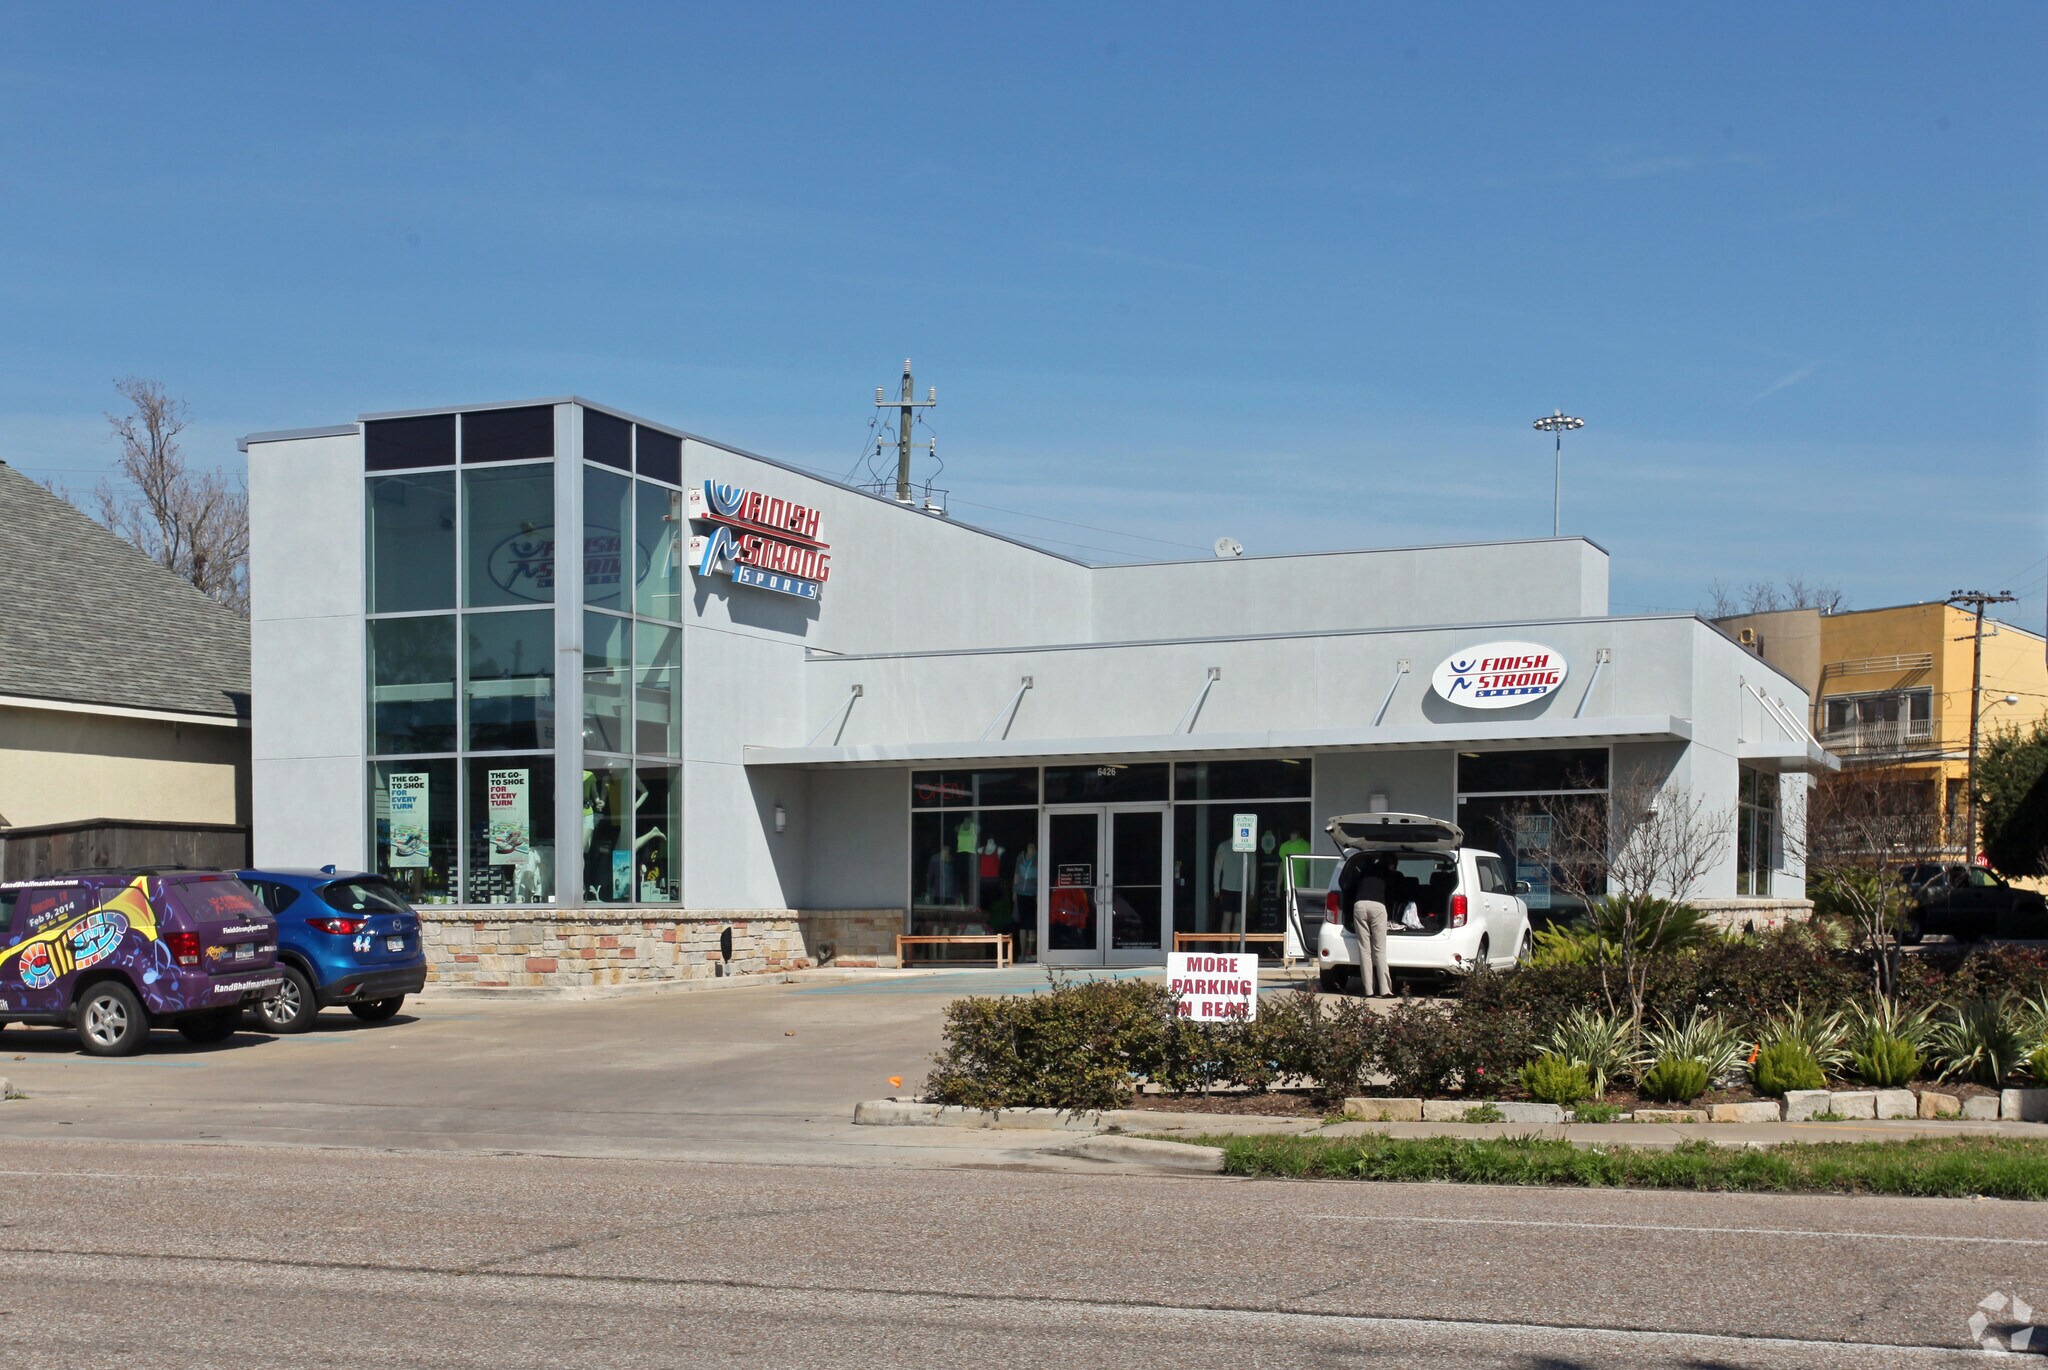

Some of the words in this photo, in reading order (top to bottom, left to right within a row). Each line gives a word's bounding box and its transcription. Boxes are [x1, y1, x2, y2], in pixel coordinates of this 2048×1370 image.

[741, 491, 821, 537] FINISH
[738, 534, 832, 582] STRONG
[742, 569, 816, 597] SPORTS
[1481, 655, 1549, 671] FINISH
[1477, 671, 1559, 689] STRONG
[1478, 688, 1545, 697] SPORTS
[1097, 768, 1116, 776] 6426
[918, 783, 964, 800] OPEN
[29, 915, 45, 928] Feb
[45, 912, 54, 920] 9,
[54, 901, 75, 917] 2014
[1187, 957, 1238, 973] MORE
[1172, 979, 1252, 995] PARKING
[1202, 1002, 1249, 1018] REAR
